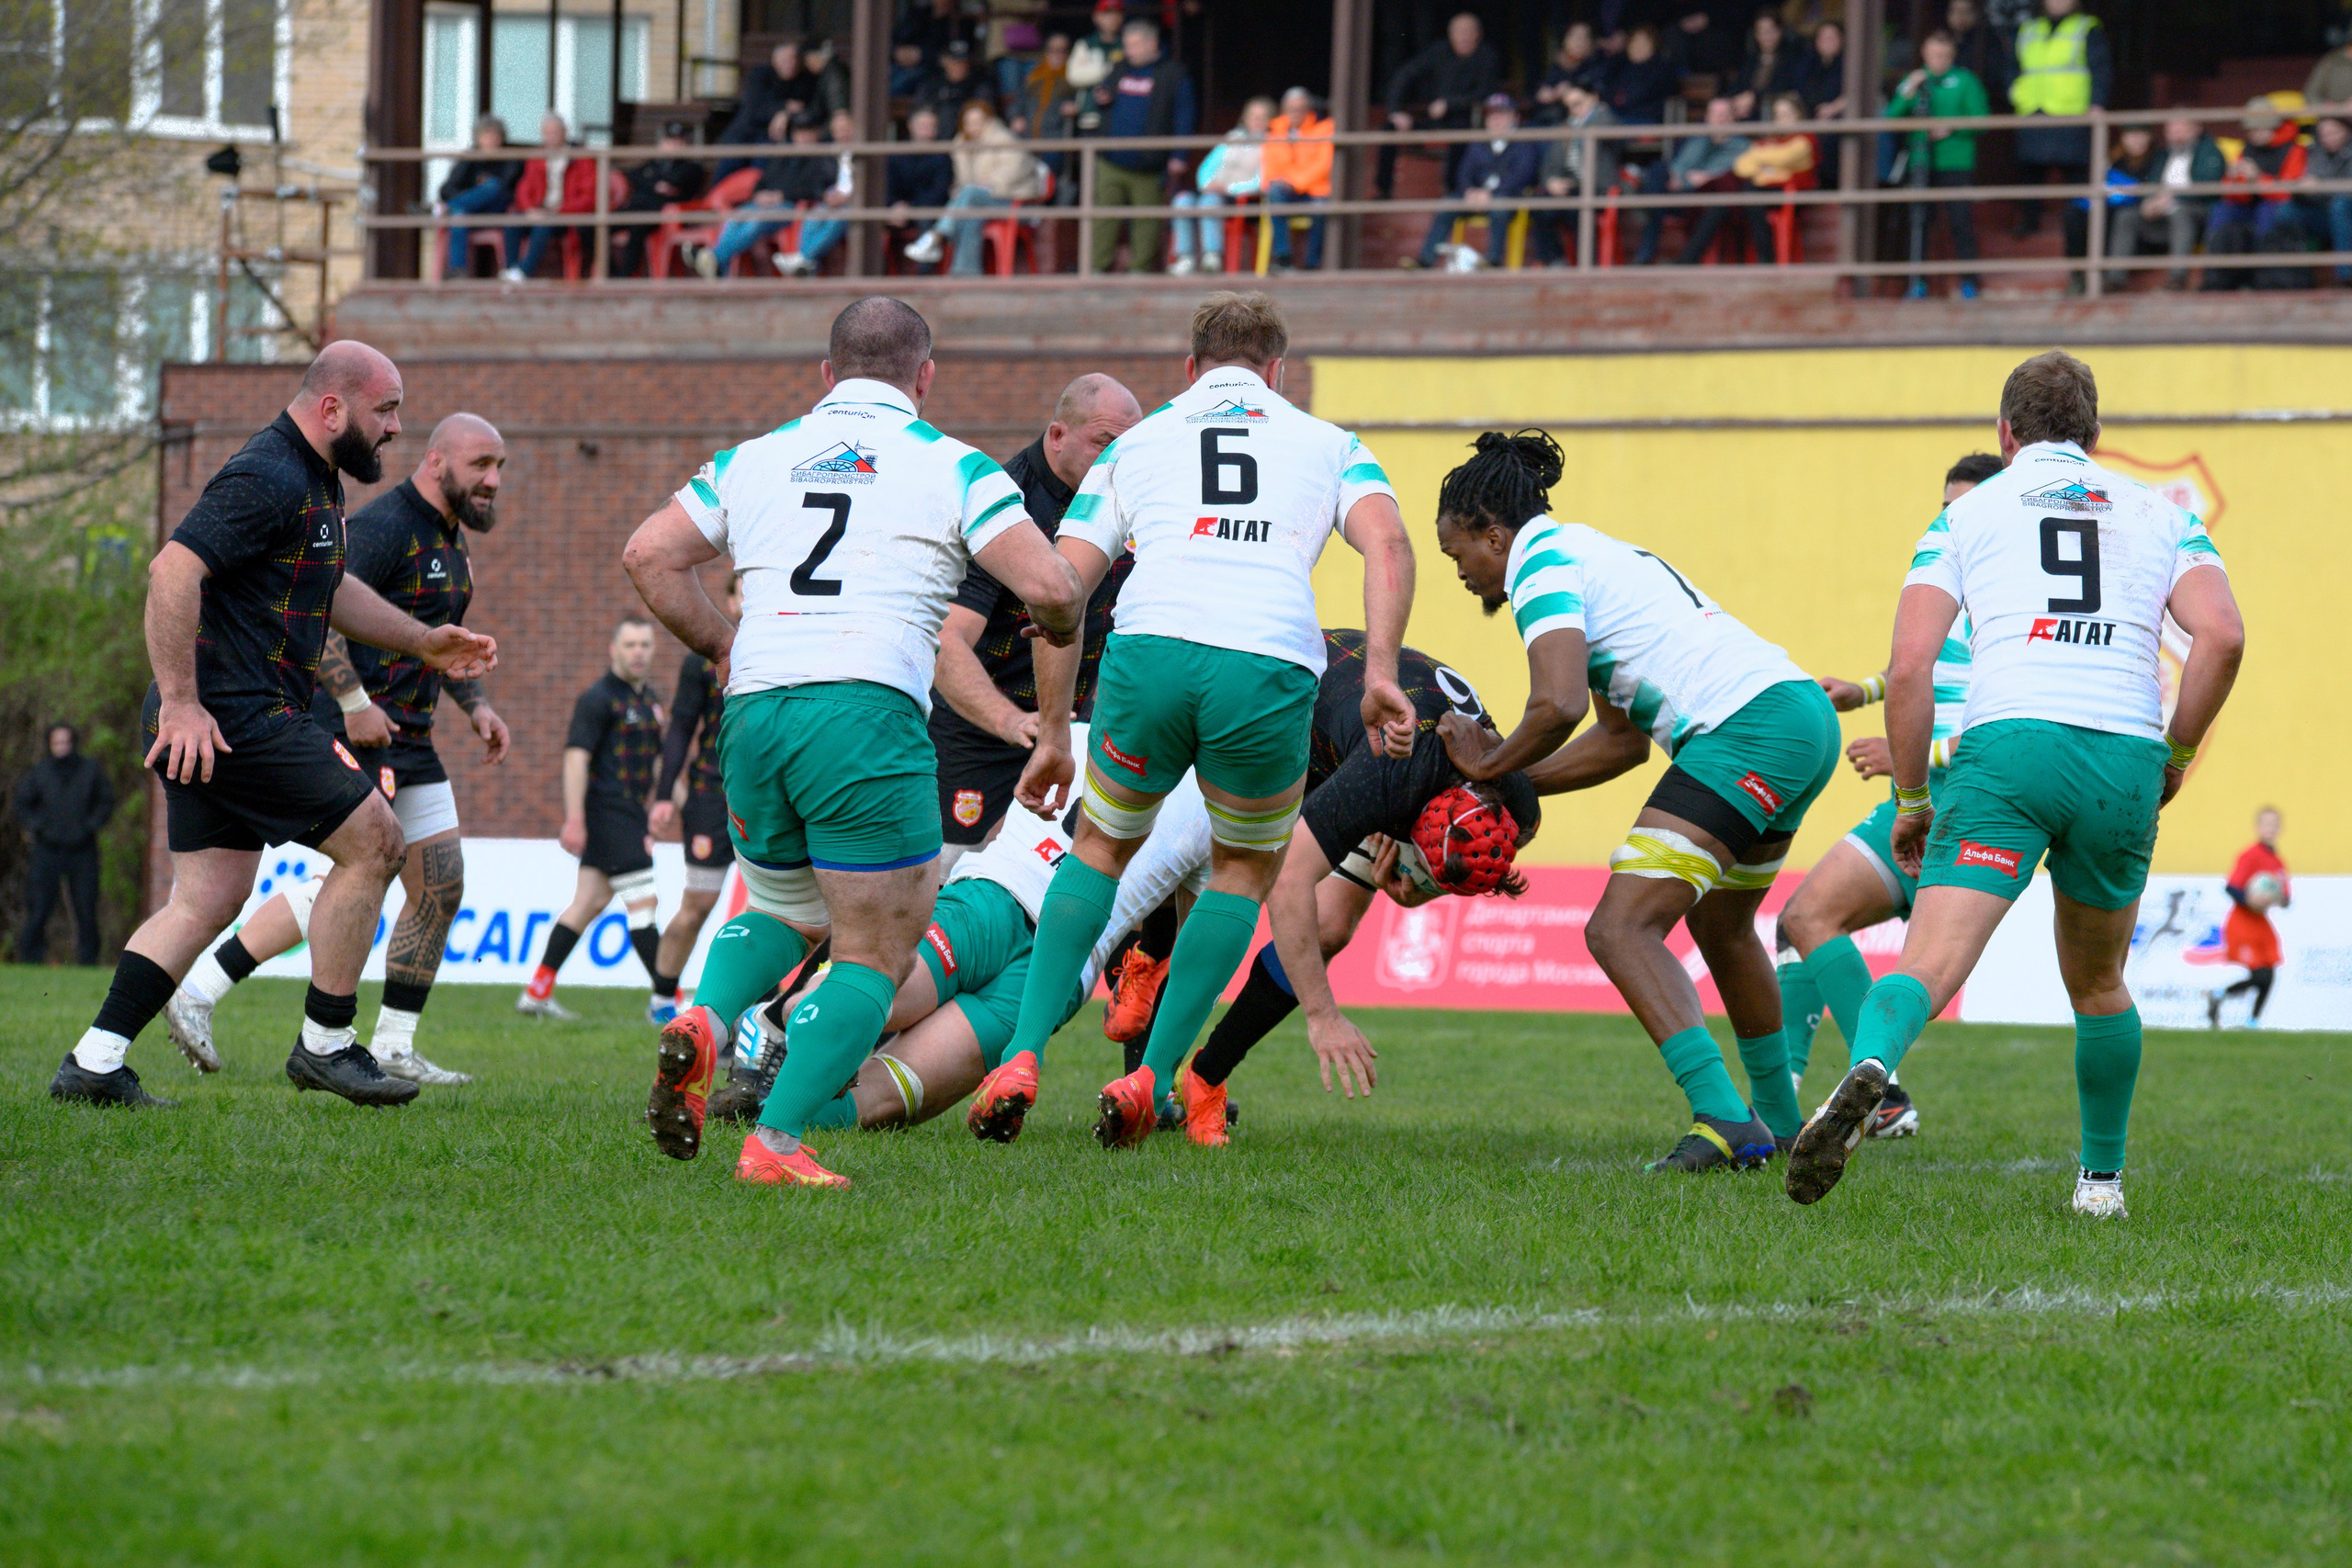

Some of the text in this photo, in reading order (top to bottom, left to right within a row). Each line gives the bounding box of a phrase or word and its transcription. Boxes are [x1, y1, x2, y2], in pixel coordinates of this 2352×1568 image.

[828, 410, 876, 419] centurion
[790, 471, 876, 479] СИБАГРОПРОМСТРОЙ
[1200, 427, 1258, 505] 6
[790, 477, 876, 486] SIBAGROPROMSTROY
[1216, 517, 1272, 542] АГАТ
[312, 540, 333, 548] centurion
[789, 491, 852, 596] 2
[2040, 517, 2101, 614] 9
[2054, 619, 2117, 646] АГАТ
[1121, 756, 1140, 769] Банк
[1963, 848, 2016, 868] Альфа Банк
[926, 930, 956, 970] Альфа Банк
